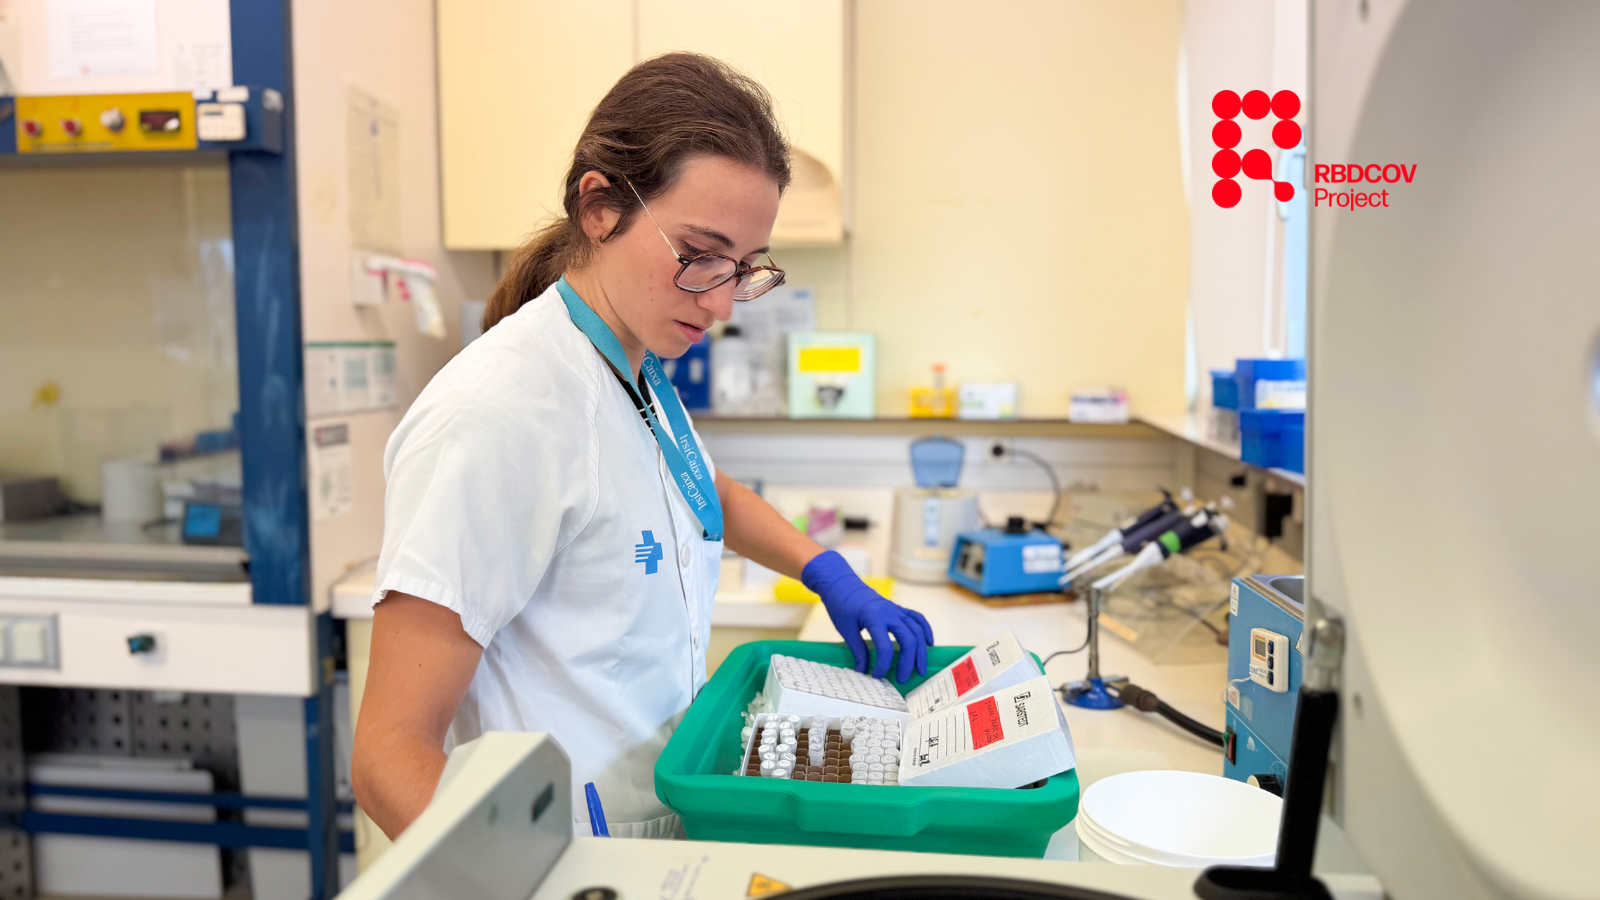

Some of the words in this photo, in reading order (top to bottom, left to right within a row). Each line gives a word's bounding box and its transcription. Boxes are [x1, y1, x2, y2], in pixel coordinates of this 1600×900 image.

[643, 352, 661, 386] Caixa
[680, 434, 702, 480] IrsiCaixa
[681, 472, 707, 510] IrsiCaixa
